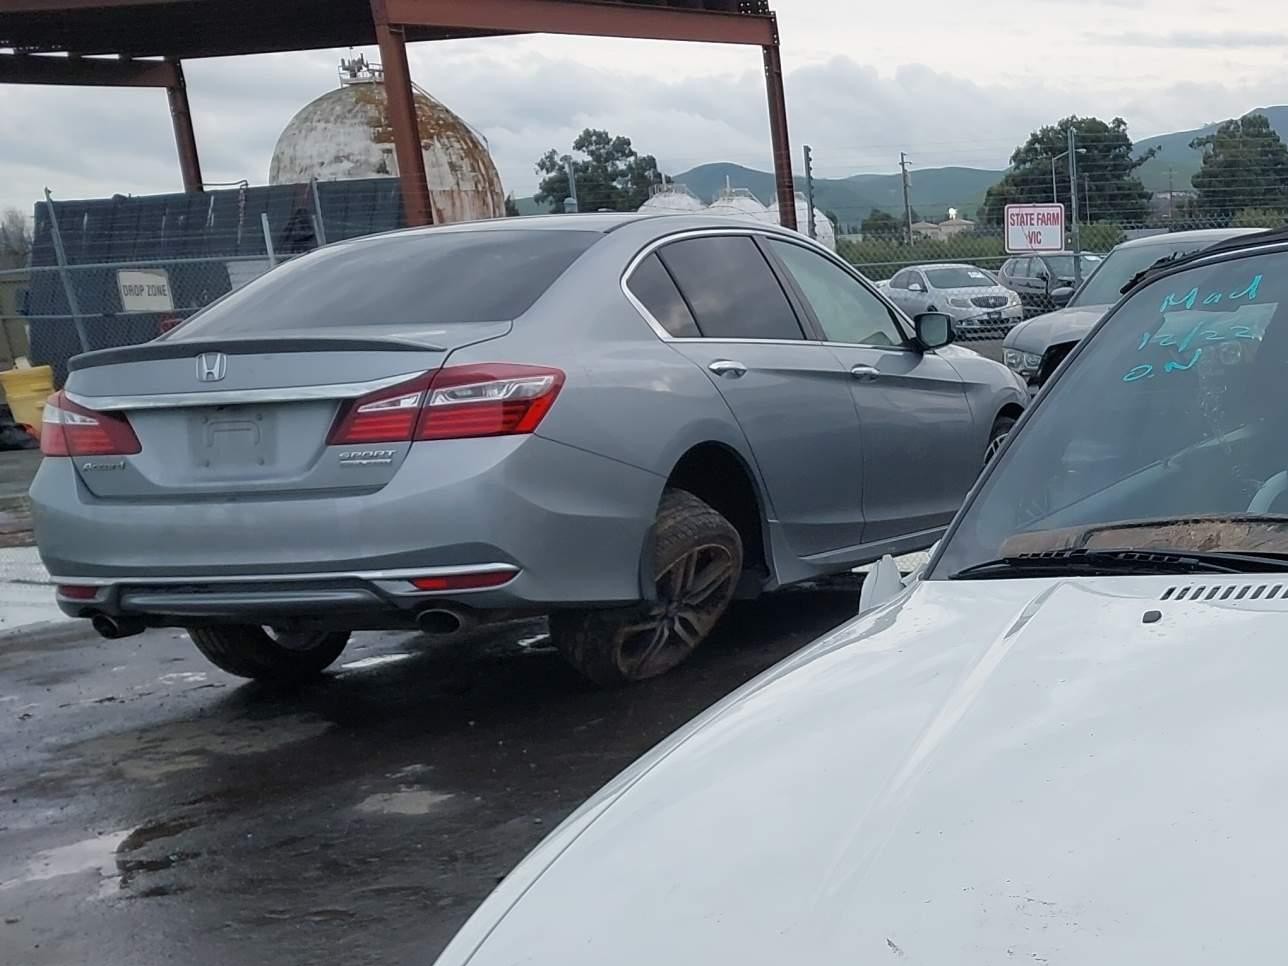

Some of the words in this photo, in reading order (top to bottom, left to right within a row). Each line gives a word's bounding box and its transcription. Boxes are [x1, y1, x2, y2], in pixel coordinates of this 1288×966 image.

[1010, 213, 1035, 226] STATE
[1037, 213, 1060, 226] FARM
[1028, 231, 1042, 244] VIC
[122, 285, 145, 296] DROP
[146, 285, 168, 296] ZONE
[1138, 321, 1255, 352] 12/22
